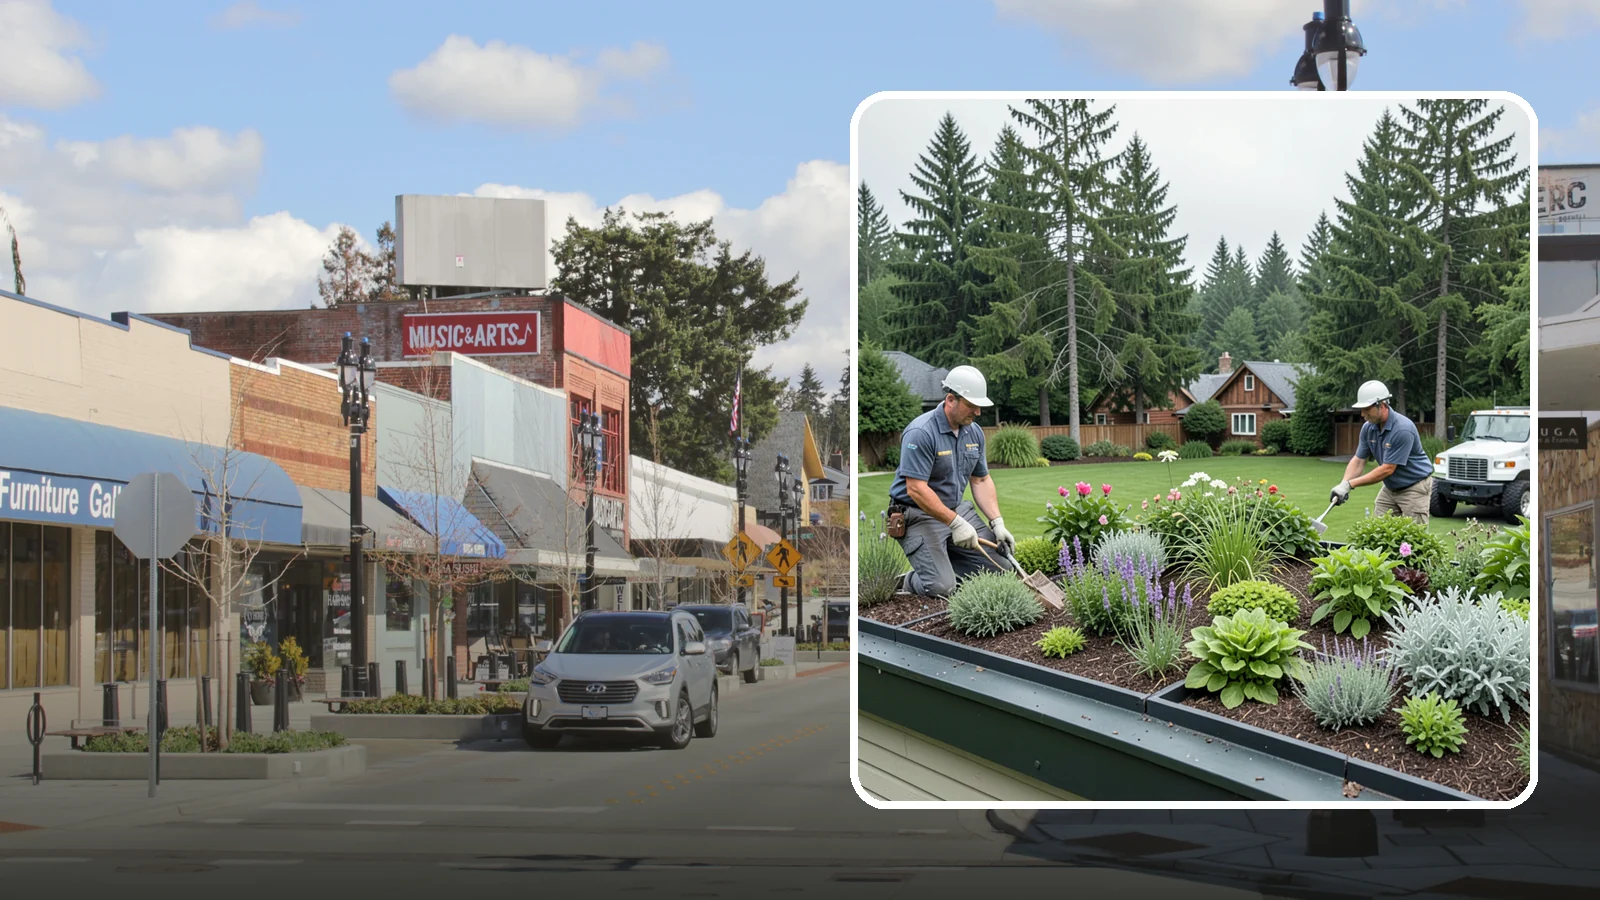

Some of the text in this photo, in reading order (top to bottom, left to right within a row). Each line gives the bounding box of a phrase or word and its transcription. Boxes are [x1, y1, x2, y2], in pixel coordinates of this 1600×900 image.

[409, 322, 520, 349] MUSIC&ARTS
[1540, 428, 1577, 436] UGA
[0, 471, 79, 515] Furniture
[453, 563, 479, 574] SUSHI
